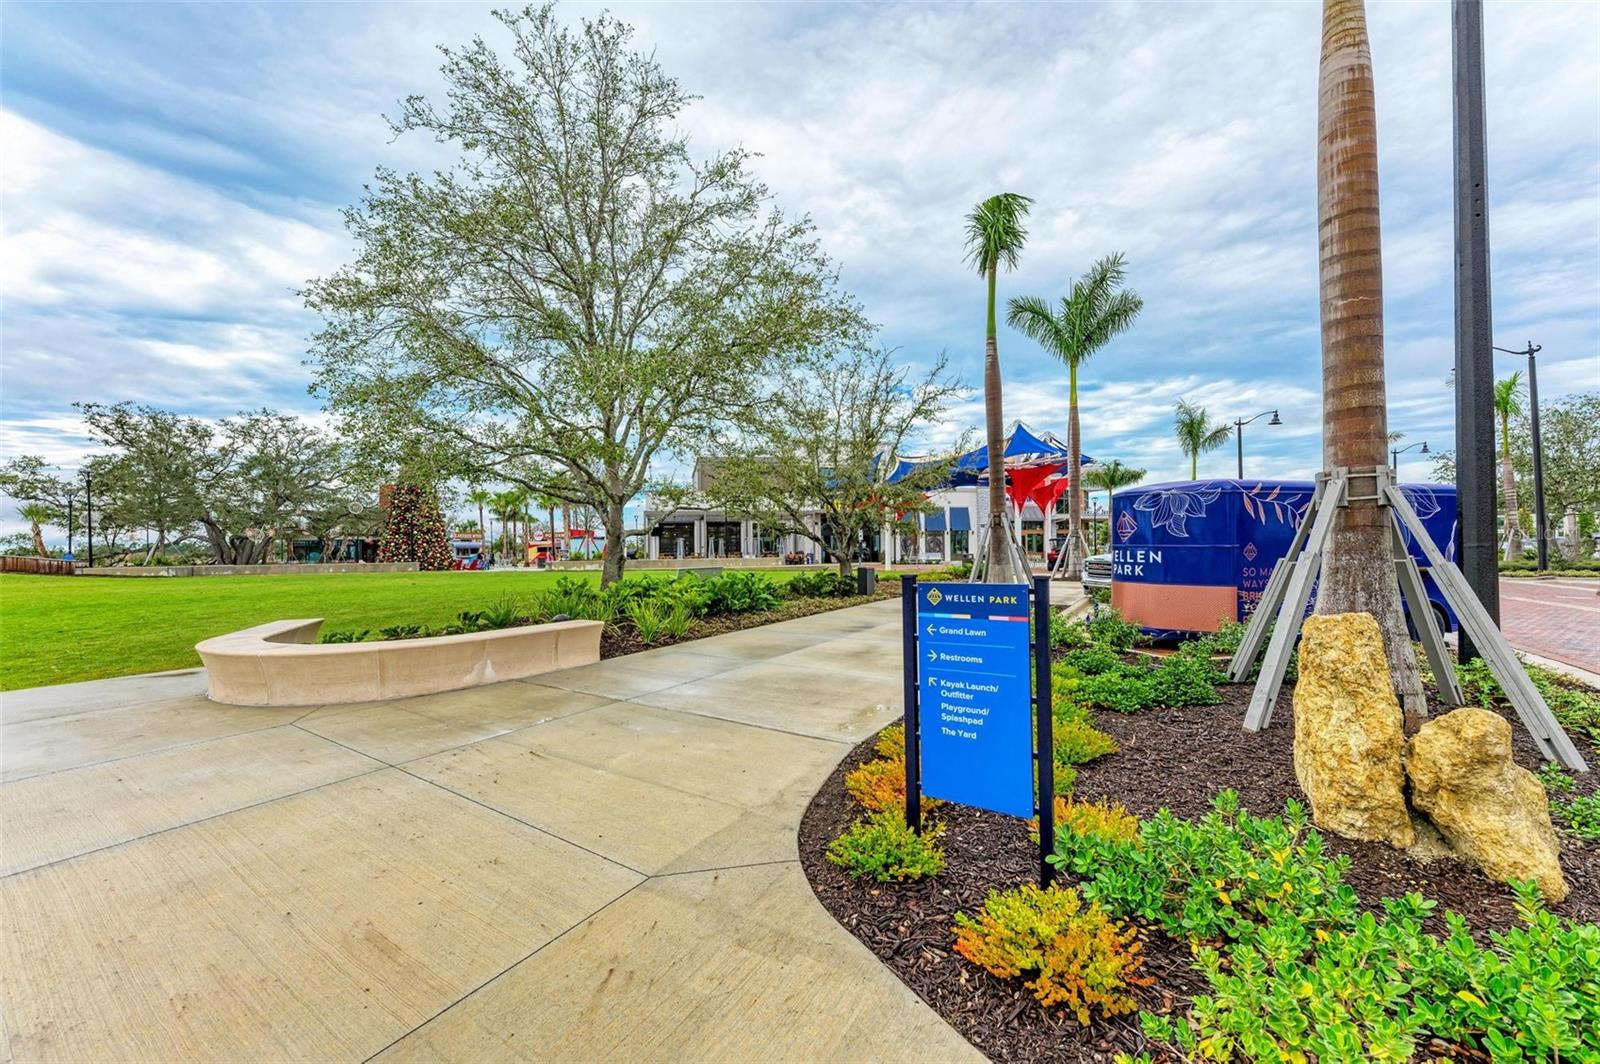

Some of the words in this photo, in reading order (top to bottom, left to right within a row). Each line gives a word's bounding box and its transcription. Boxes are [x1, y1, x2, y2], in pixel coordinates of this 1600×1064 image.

[1112, 550, 1162, 564] ELLEN
[1113, 564, 1144, 576] PARK
[1242, 567, 1256, 577] SO
[1259, 567, 1273, 577] MA
[945, 594, 984, 603] WELLEN
[989, 596, 1017, 604] PARK
[939, 626, 964, 635] Grand
[965, 627, 986, 637] Lawn
[940, 653, 983, 663] Restrooms
[940, 679, 965, 689] Kayak
[966, 682, 999, 693] Launch/
[940, 690, 974, 700] Outfitter
[941, 702, 990, 716] Playground/
[941, 712, 983, 726] Splashpad
[941, 727, 956, 736] The
[957, 729, 977, 739] Yard
